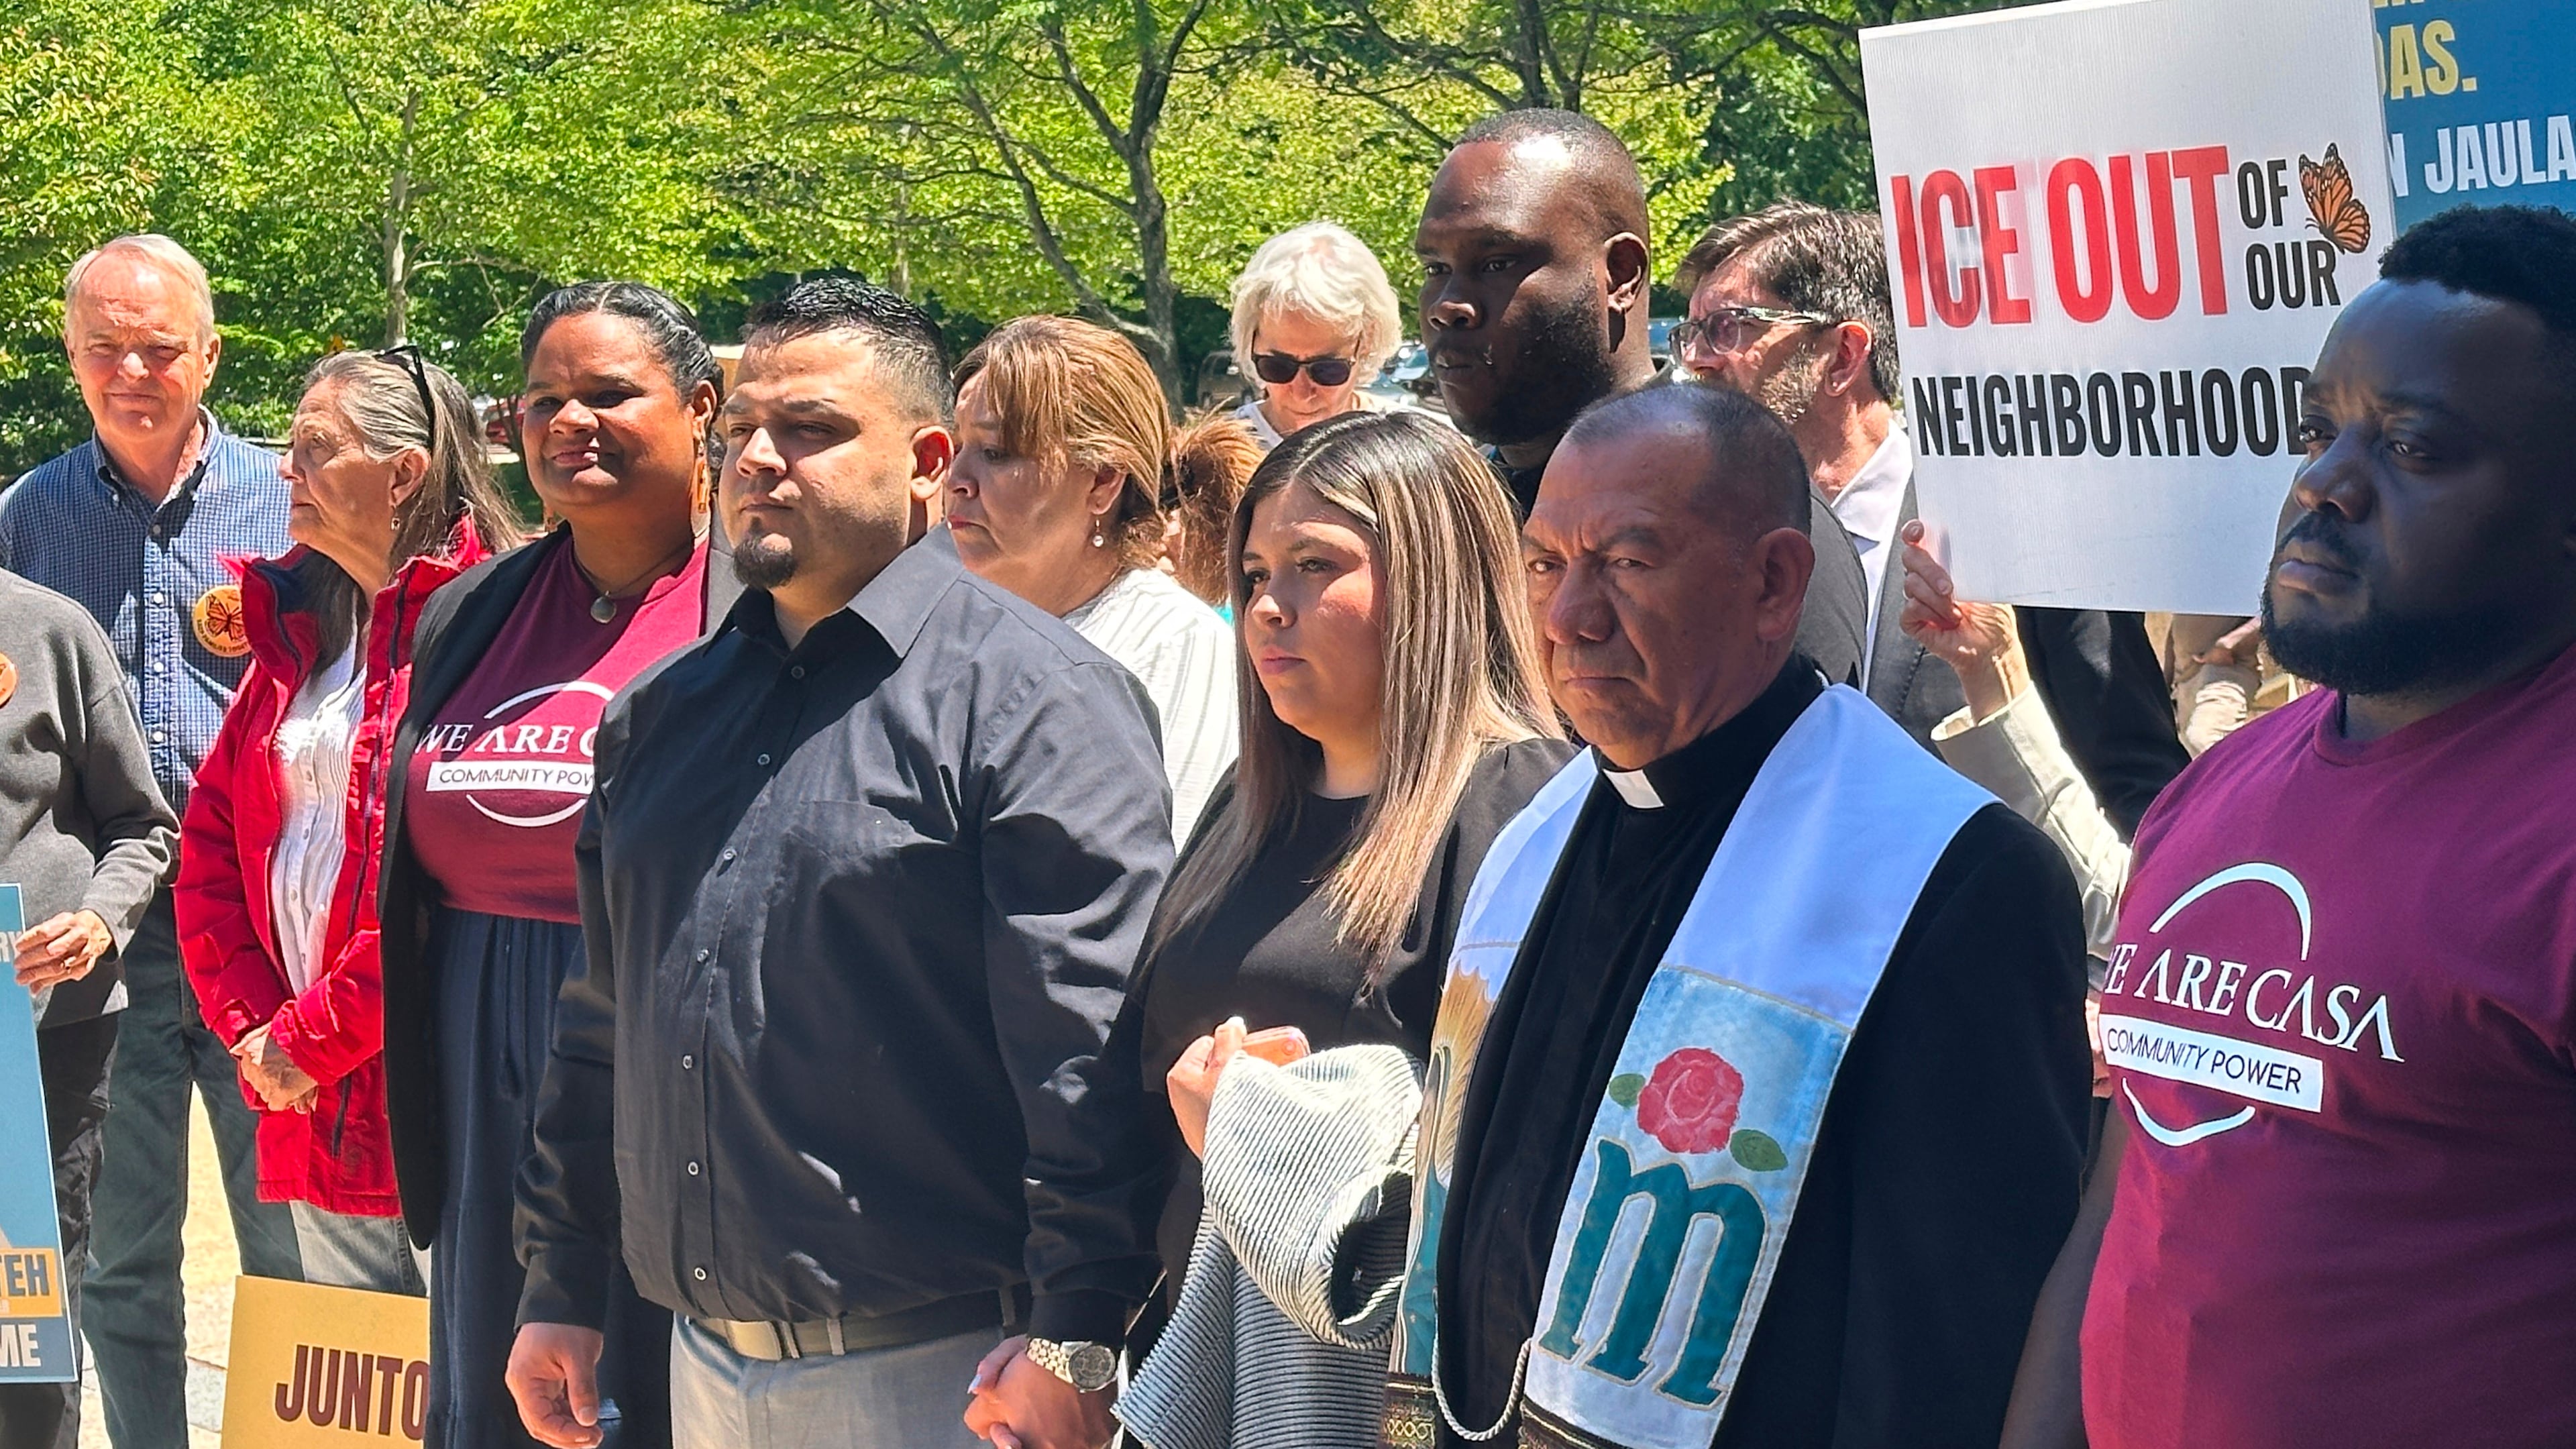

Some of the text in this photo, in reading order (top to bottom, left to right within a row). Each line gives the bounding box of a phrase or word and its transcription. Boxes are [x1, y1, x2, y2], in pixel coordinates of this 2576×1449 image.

[2375, 19, 2477, 100] AS.
[2424, 114, 2576, 194] JAULA
[2237, 159, 2289, 230] OF
[1890, 146, 2229, 329] ICE OUT
[2245, 239, 2341, 311] OUR
[415, 723, 474, 754] WE
[474, 724, 576, 754] ARE
[439, 768, 553, 784] COMMUNITY
[2104, 943, 2405, 1063] E ARE CASA
[2107, 1028, 2301, 1094] COMMUNITY POWER
[274, 1344, 431, 1441] JUNTO
